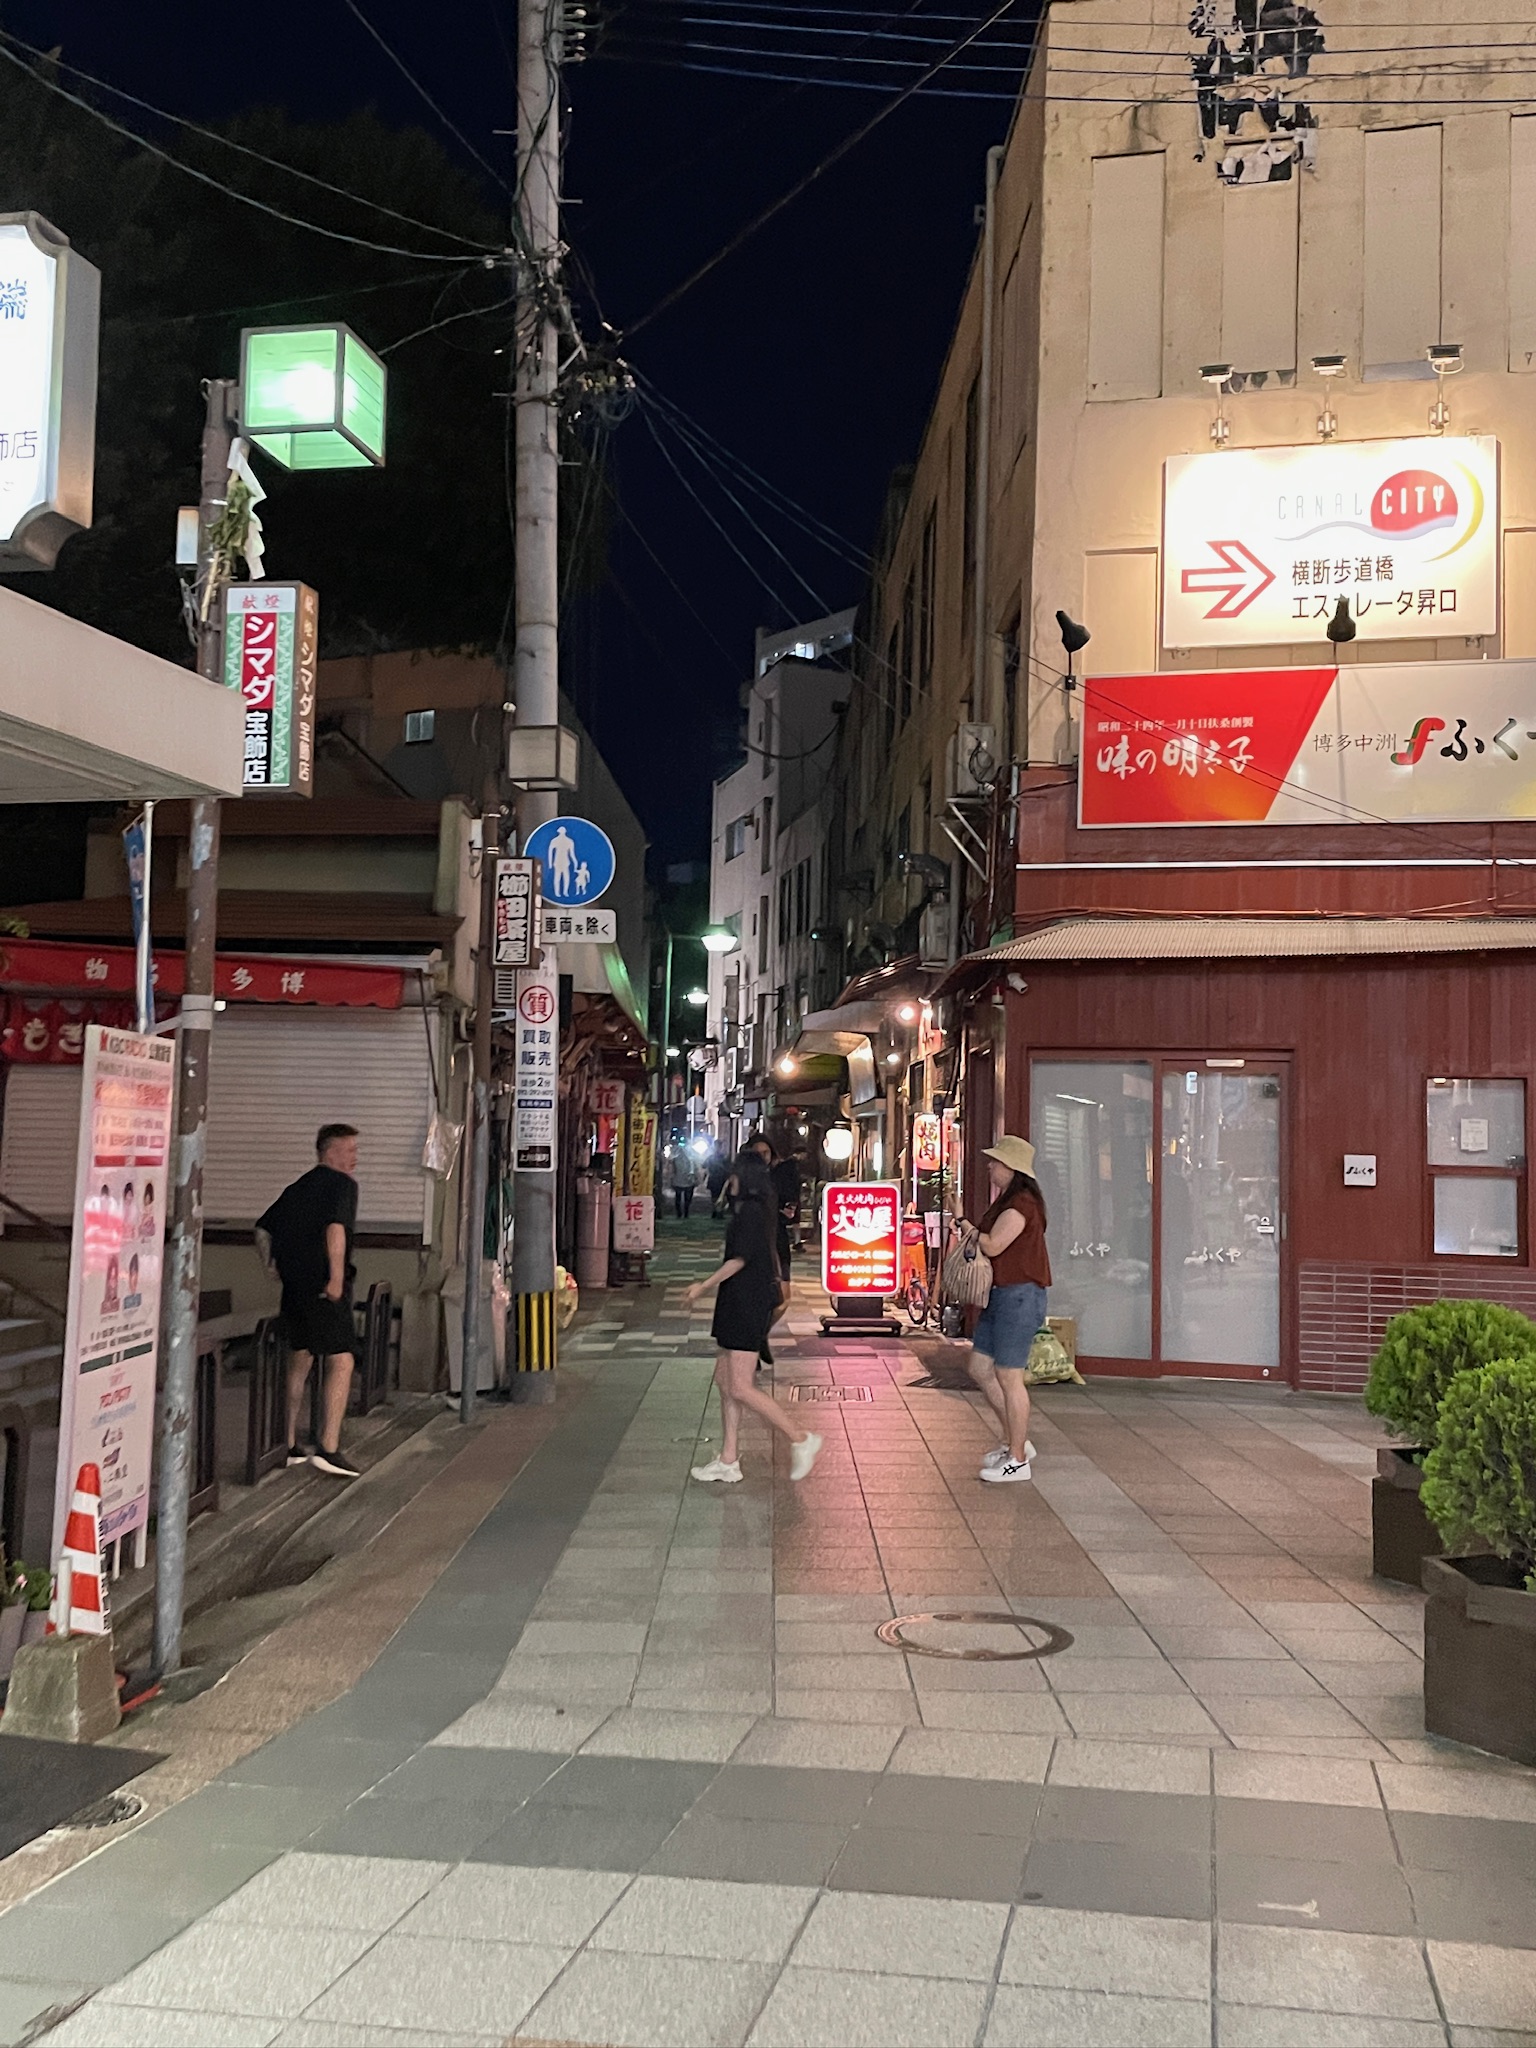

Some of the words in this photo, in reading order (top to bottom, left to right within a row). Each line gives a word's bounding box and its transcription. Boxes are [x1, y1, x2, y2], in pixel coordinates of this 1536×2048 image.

[1278, 492, 1363, 520] CANAL
[1381, 484, 1446, 515] CITY
[1292, 555, 1394, 586] 横断歩道橋
[1313, 733, 1397, 753] 博多中洲
[1440, 718, 1536, 762] ふく
[1096, 734, 1255, 781] 味の明太子
[541, 916, 609, 935] 車両を除く
[527, 992, 548, 1016] 質
[522, 1029, 551, 1044] 買取
[521, 1050, 551, 1066] 販売
[595, 1084, 618, 1110] 花
[625, 1200, 644, 1221] 花
[1070, 1241, 1111, 1257] ふくや
[1199, 1246, 1242, 1263] ふくや
